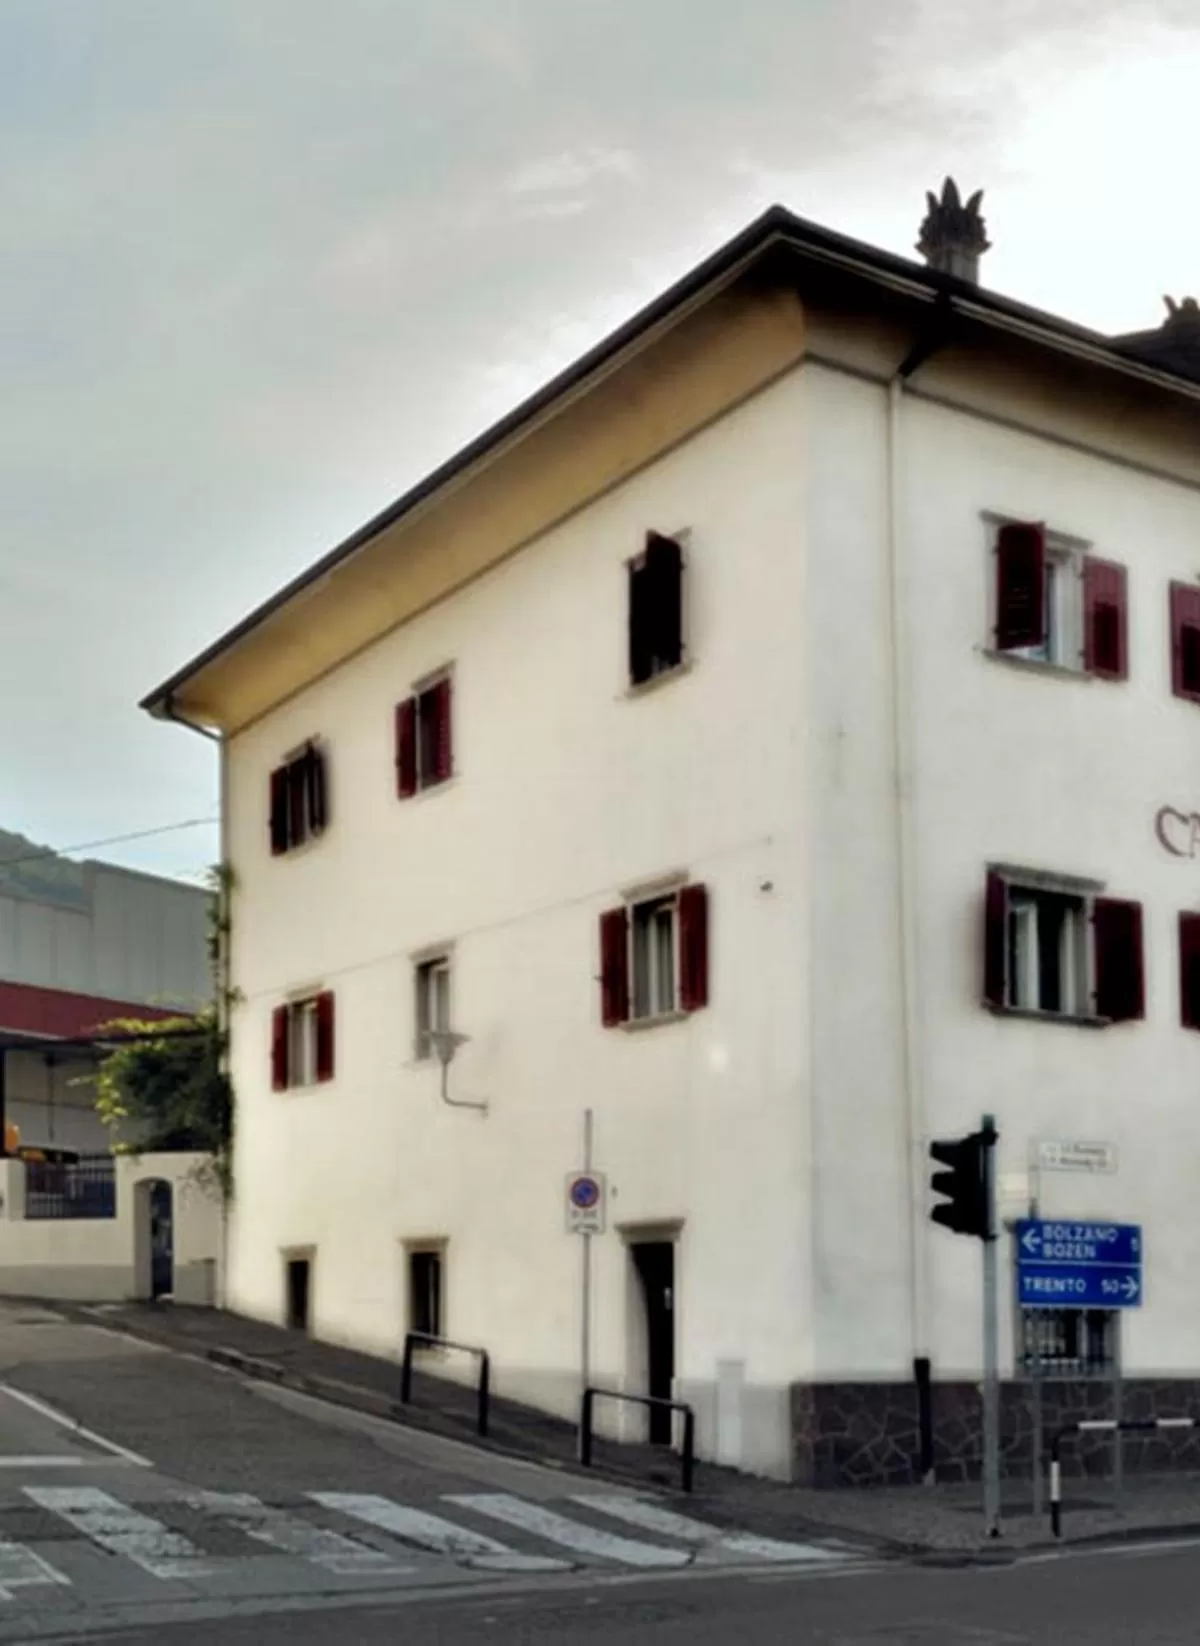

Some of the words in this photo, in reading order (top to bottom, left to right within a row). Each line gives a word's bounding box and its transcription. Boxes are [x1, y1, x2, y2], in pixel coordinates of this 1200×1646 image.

[1042, 1223, 1119, 1243] BOLZANO
[1042, 1243, 1097, 1259] BOZEN
[1023, 1275, 1087, 1293] TRENTO
